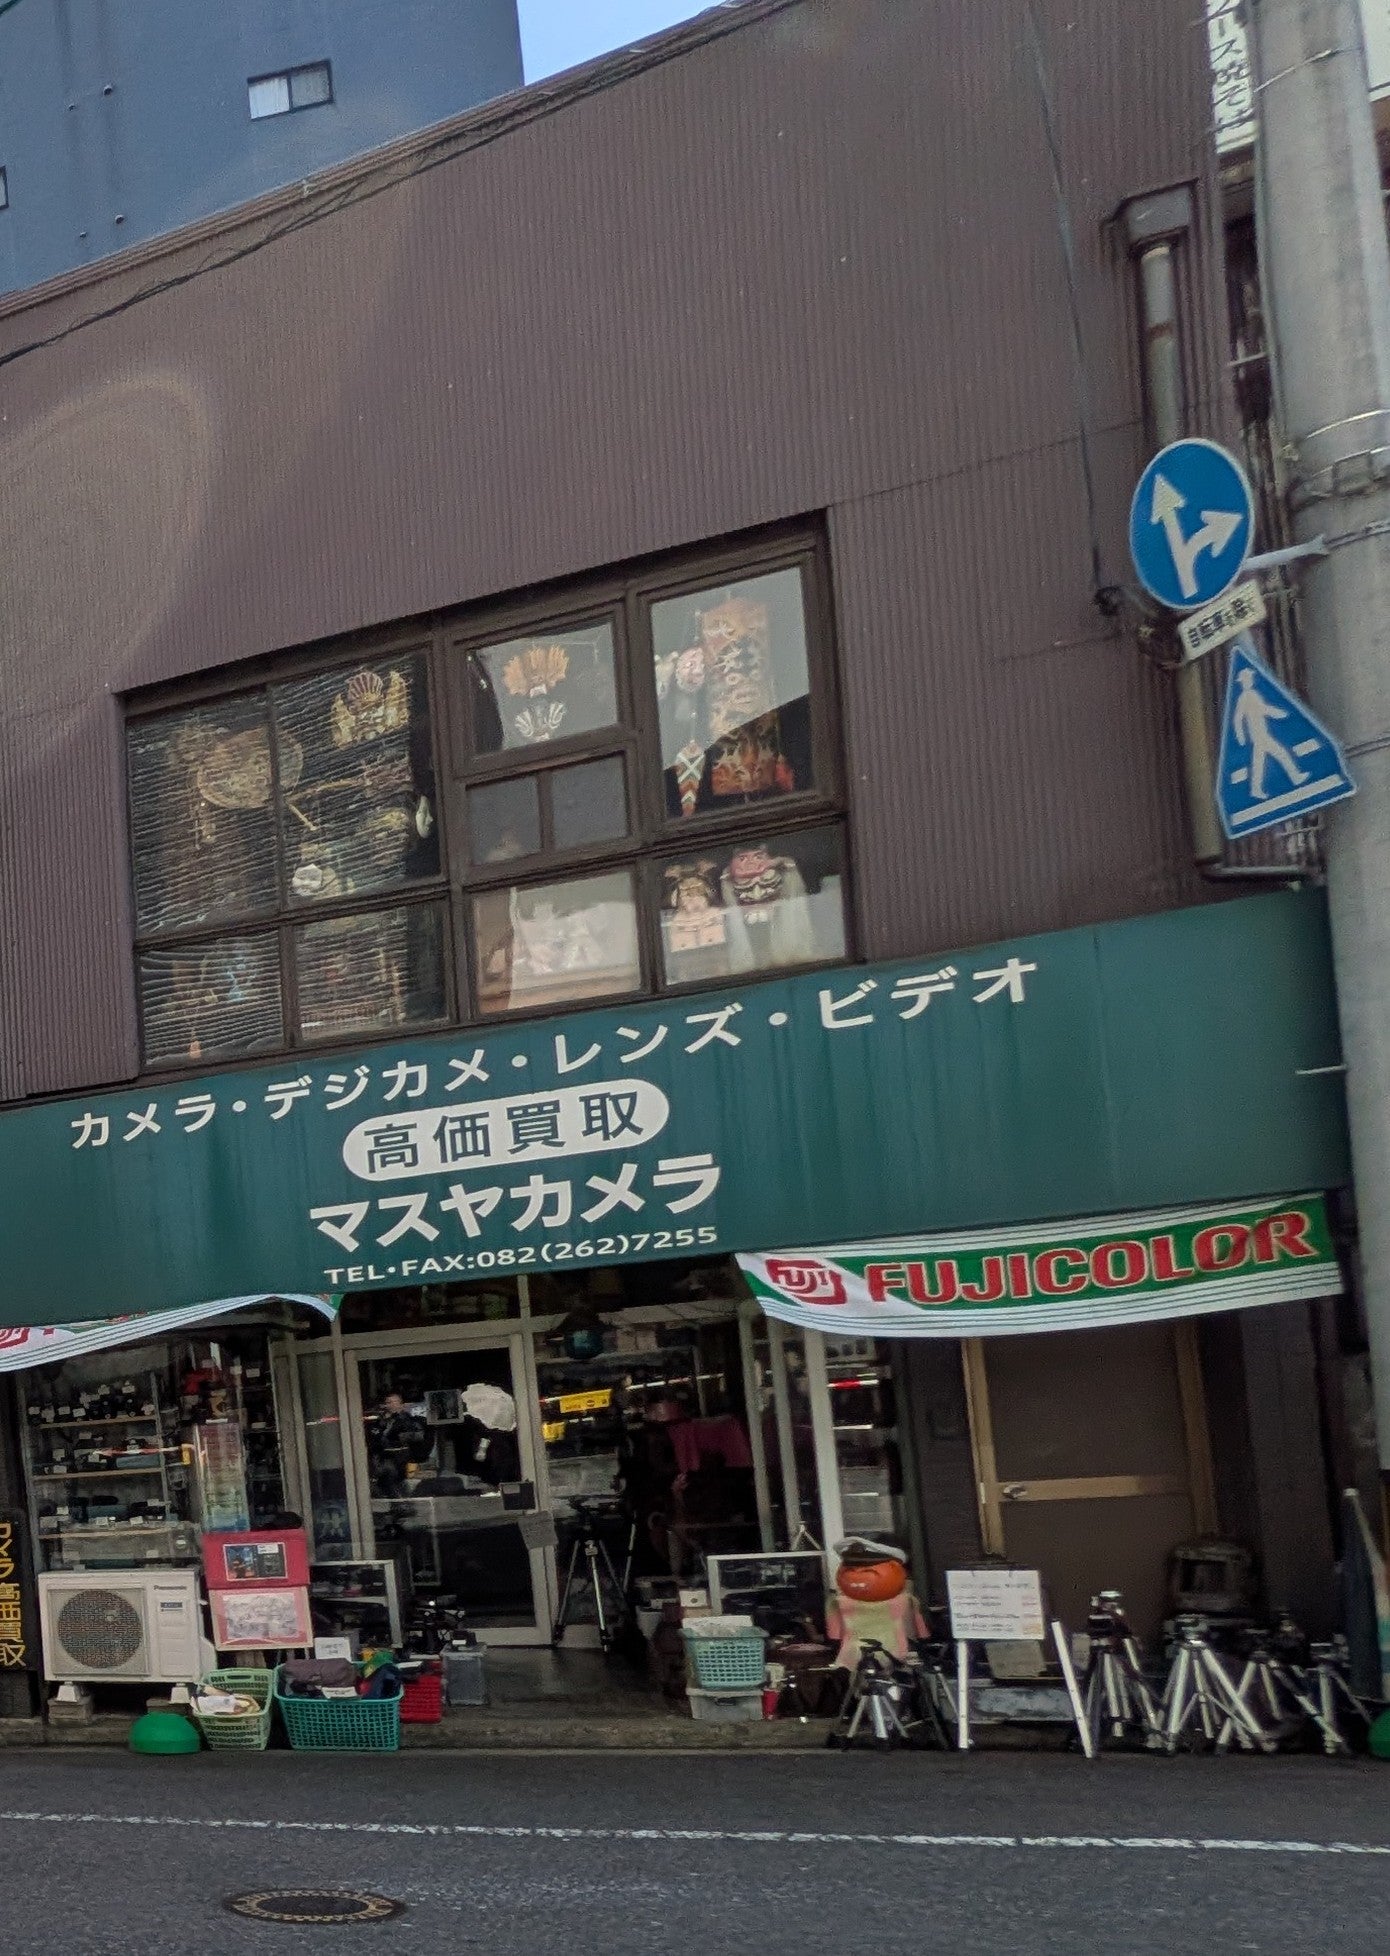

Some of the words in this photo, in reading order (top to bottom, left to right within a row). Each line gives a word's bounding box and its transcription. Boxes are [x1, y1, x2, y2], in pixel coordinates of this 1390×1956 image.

[364, 1090, 645, 1174] 高価買取
[309, 1152, 721, 1253] マスヤカメラ
[770, 1260, 842, 1303] FUJI
[866, 1210, 1318, 1304] FUJICOLOR
